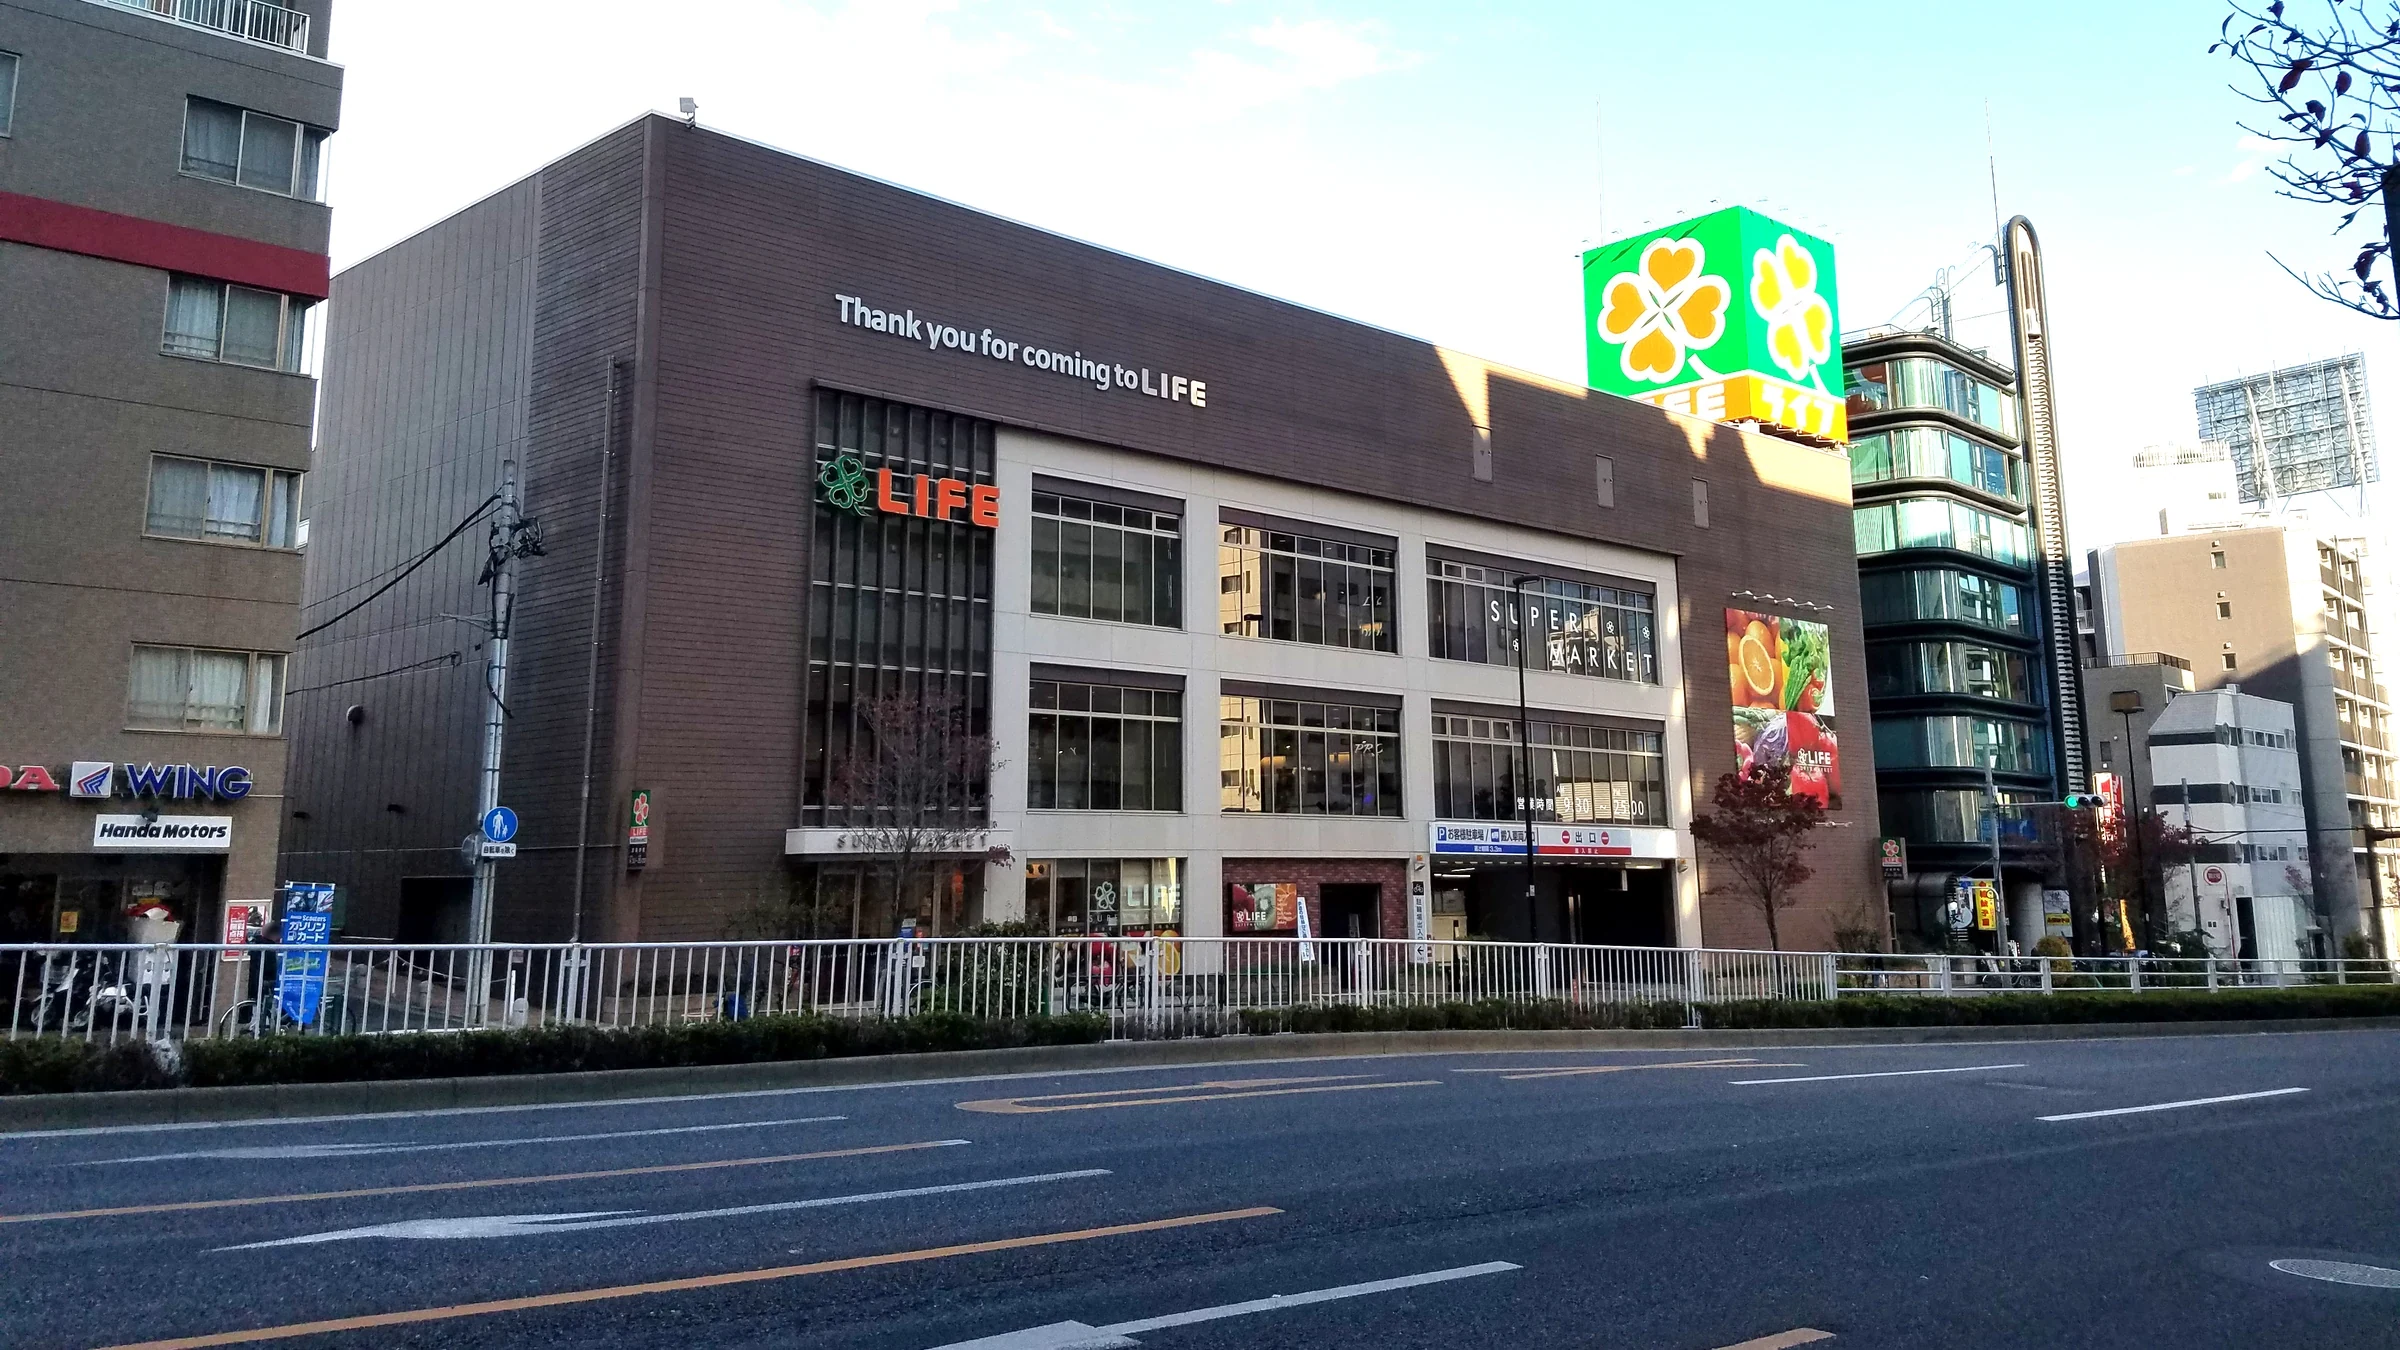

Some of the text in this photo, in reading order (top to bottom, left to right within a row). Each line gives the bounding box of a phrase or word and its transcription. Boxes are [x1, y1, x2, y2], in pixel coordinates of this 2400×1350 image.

[836, 294, 1206, 408] Thank you for coming to LIFE
[878, 468, 1000, 529] LIFE
[1490, 600, 1580, 633] SUPER
[1550, 643, 1652, 674] MARKET
[1808, 750, 1831, 765] LIFE
[124, 761, 253, 800] WING
[99, 823, 227, 840] Handa Motors
[632, 828, 647, 836] LIFE
[1448, 828, 1484, 841] お客様駐車場
[1575, 831, 1597, 844] 出口
[1127, 884, 1181, 907] LIFE
[1245, 911, 1266, 921] LIFE
[289, 921, 326, 932] ガソリン
[297, 932, 325, 943] カード
